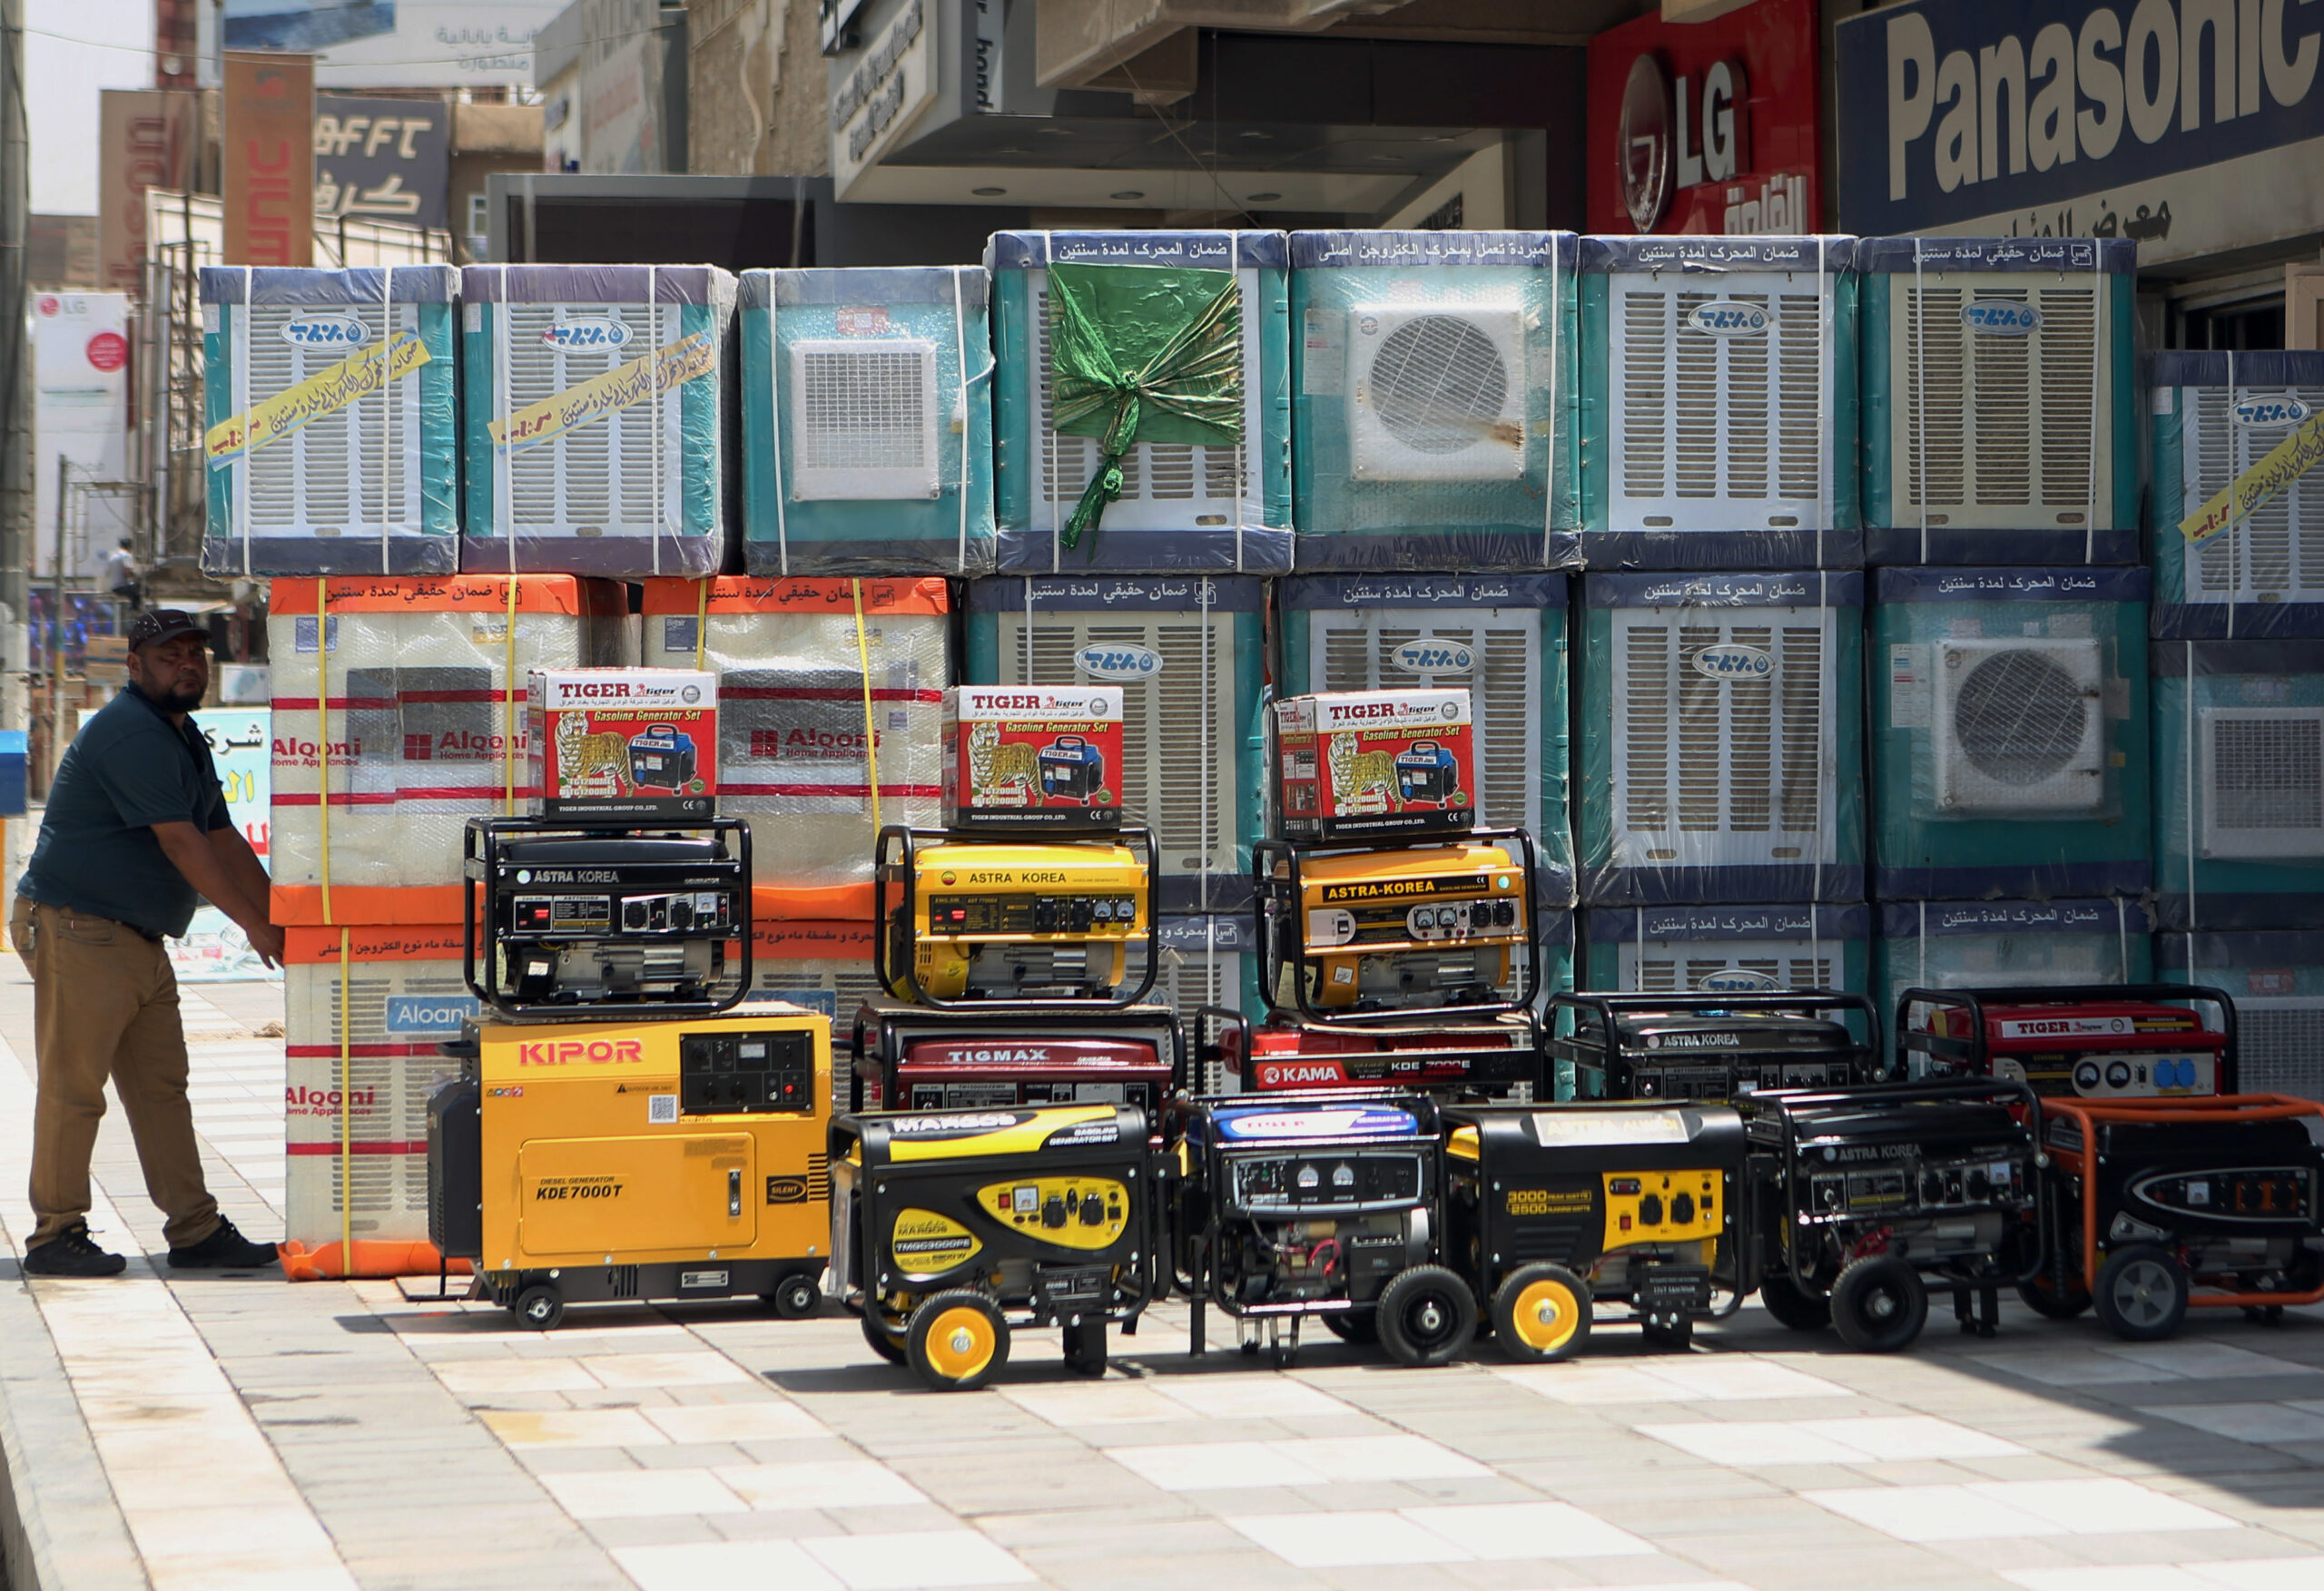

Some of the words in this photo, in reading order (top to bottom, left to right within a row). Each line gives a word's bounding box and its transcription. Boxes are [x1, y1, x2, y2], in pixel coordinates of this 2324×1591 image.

[1886, 0, 2324, 201] Panasonic
[1676, 60, 1735, 190] LG
[1059, 242, 1098, 260] سنتين
[1102, 241, 1129, 256] لمدة
[1189, 241, 1228, 259] ضمان
[1638, 245, 1676, 262] سنتين
[1679, 244, 1706, 259] لمدة
[1762, 244, 1799, 262] ضمان
[1955, 243, 1982, 260] لمدة
[2029, 244, 2065, 262] ضمان
[370, 582, 399, 598] لمدة
[1069, 583, 1098, 596] لمدة
[1685, 582, 1711, 596] لمدة
[1938, 575, 1975, 593] سنتين
[1979, 575, 2004, 589] لمدة
[2061, 575, 2096, 591] ضمان
[324, 584, 366, 604] سنتين
[452, 583, 494, 601] ضمان
[745, 585, 773, 600] لمدة
[1148, 583, 1188, 601] ضمان
[1343, 585, 1382, 603] سنتين
[1385, 584, 1412, 599] لمدة
[1471, 584, 1510, 602] ضمان
[1644, 584, 1681, 600] سنتين
[1768, 583, 1806, 598] ضمان
[558, 683, 631, 698] TIGER
[971, 695, 1040, 710] TIGER
[594, 711, 634, 722] Gasoline
[636, 710, 683, 722] Generator
[684, 710, 702, 721] Set
[1330, 702, 1395, 721] TIGER
[1005, 722, 1044, 733] Gasoline
[1046, 722, 1091, 733] Generator
[1092, 722, 1109, 732] Set
[1363, 729, 1400, 741] Gasoline
[1401, 727, 1444, 739] Generator
[1445, 725, 1461, 737] Set
[202, 723, 264, 756] شرك
[439, 751, 472, 761] Home
[534, 870, 575, 884] ASTRA
[577, 869, 620, 884] KOREA
[969, 872, 1013, 884] ASTRA
[1022, 872, 1067, 884] KOREA
[1327, 879, 1435, 900] ASTRA-KOREA
[1690, 916, 1718, 930] لمدة
[1942, 911, 1978, 927] سنتين
[1982, 908, 2008, 923] لمدة
[2063, 908, 2099, 922] ضمان
[1649, 917, 1687, 934] سنتين
[1774, 916, 1811, 932] ضمان
[2018, 1021, 2071, 1034] TIGER
[1663, 1035, 1700, 1047] ASTRA
[1701, 1033, 1740, 1046] KOREA
[519, 1037, 644, 1066] KIPOR
[949, 1048, 1049, 1063] TIGMAX
[1391, 1060, 1421, 1071] KDE
[1283, 1066, 1340, 1083] KAMA
[1839, 1147, 1877, 1162] ASTRA
[1881, 1144, 1923, 1159] KOREA
[540, 1177, 566, 1185] DIESEL
[568, 1176, 615, 1184] GENERATOR
[771, 1185, 800, 1195] SILENT
